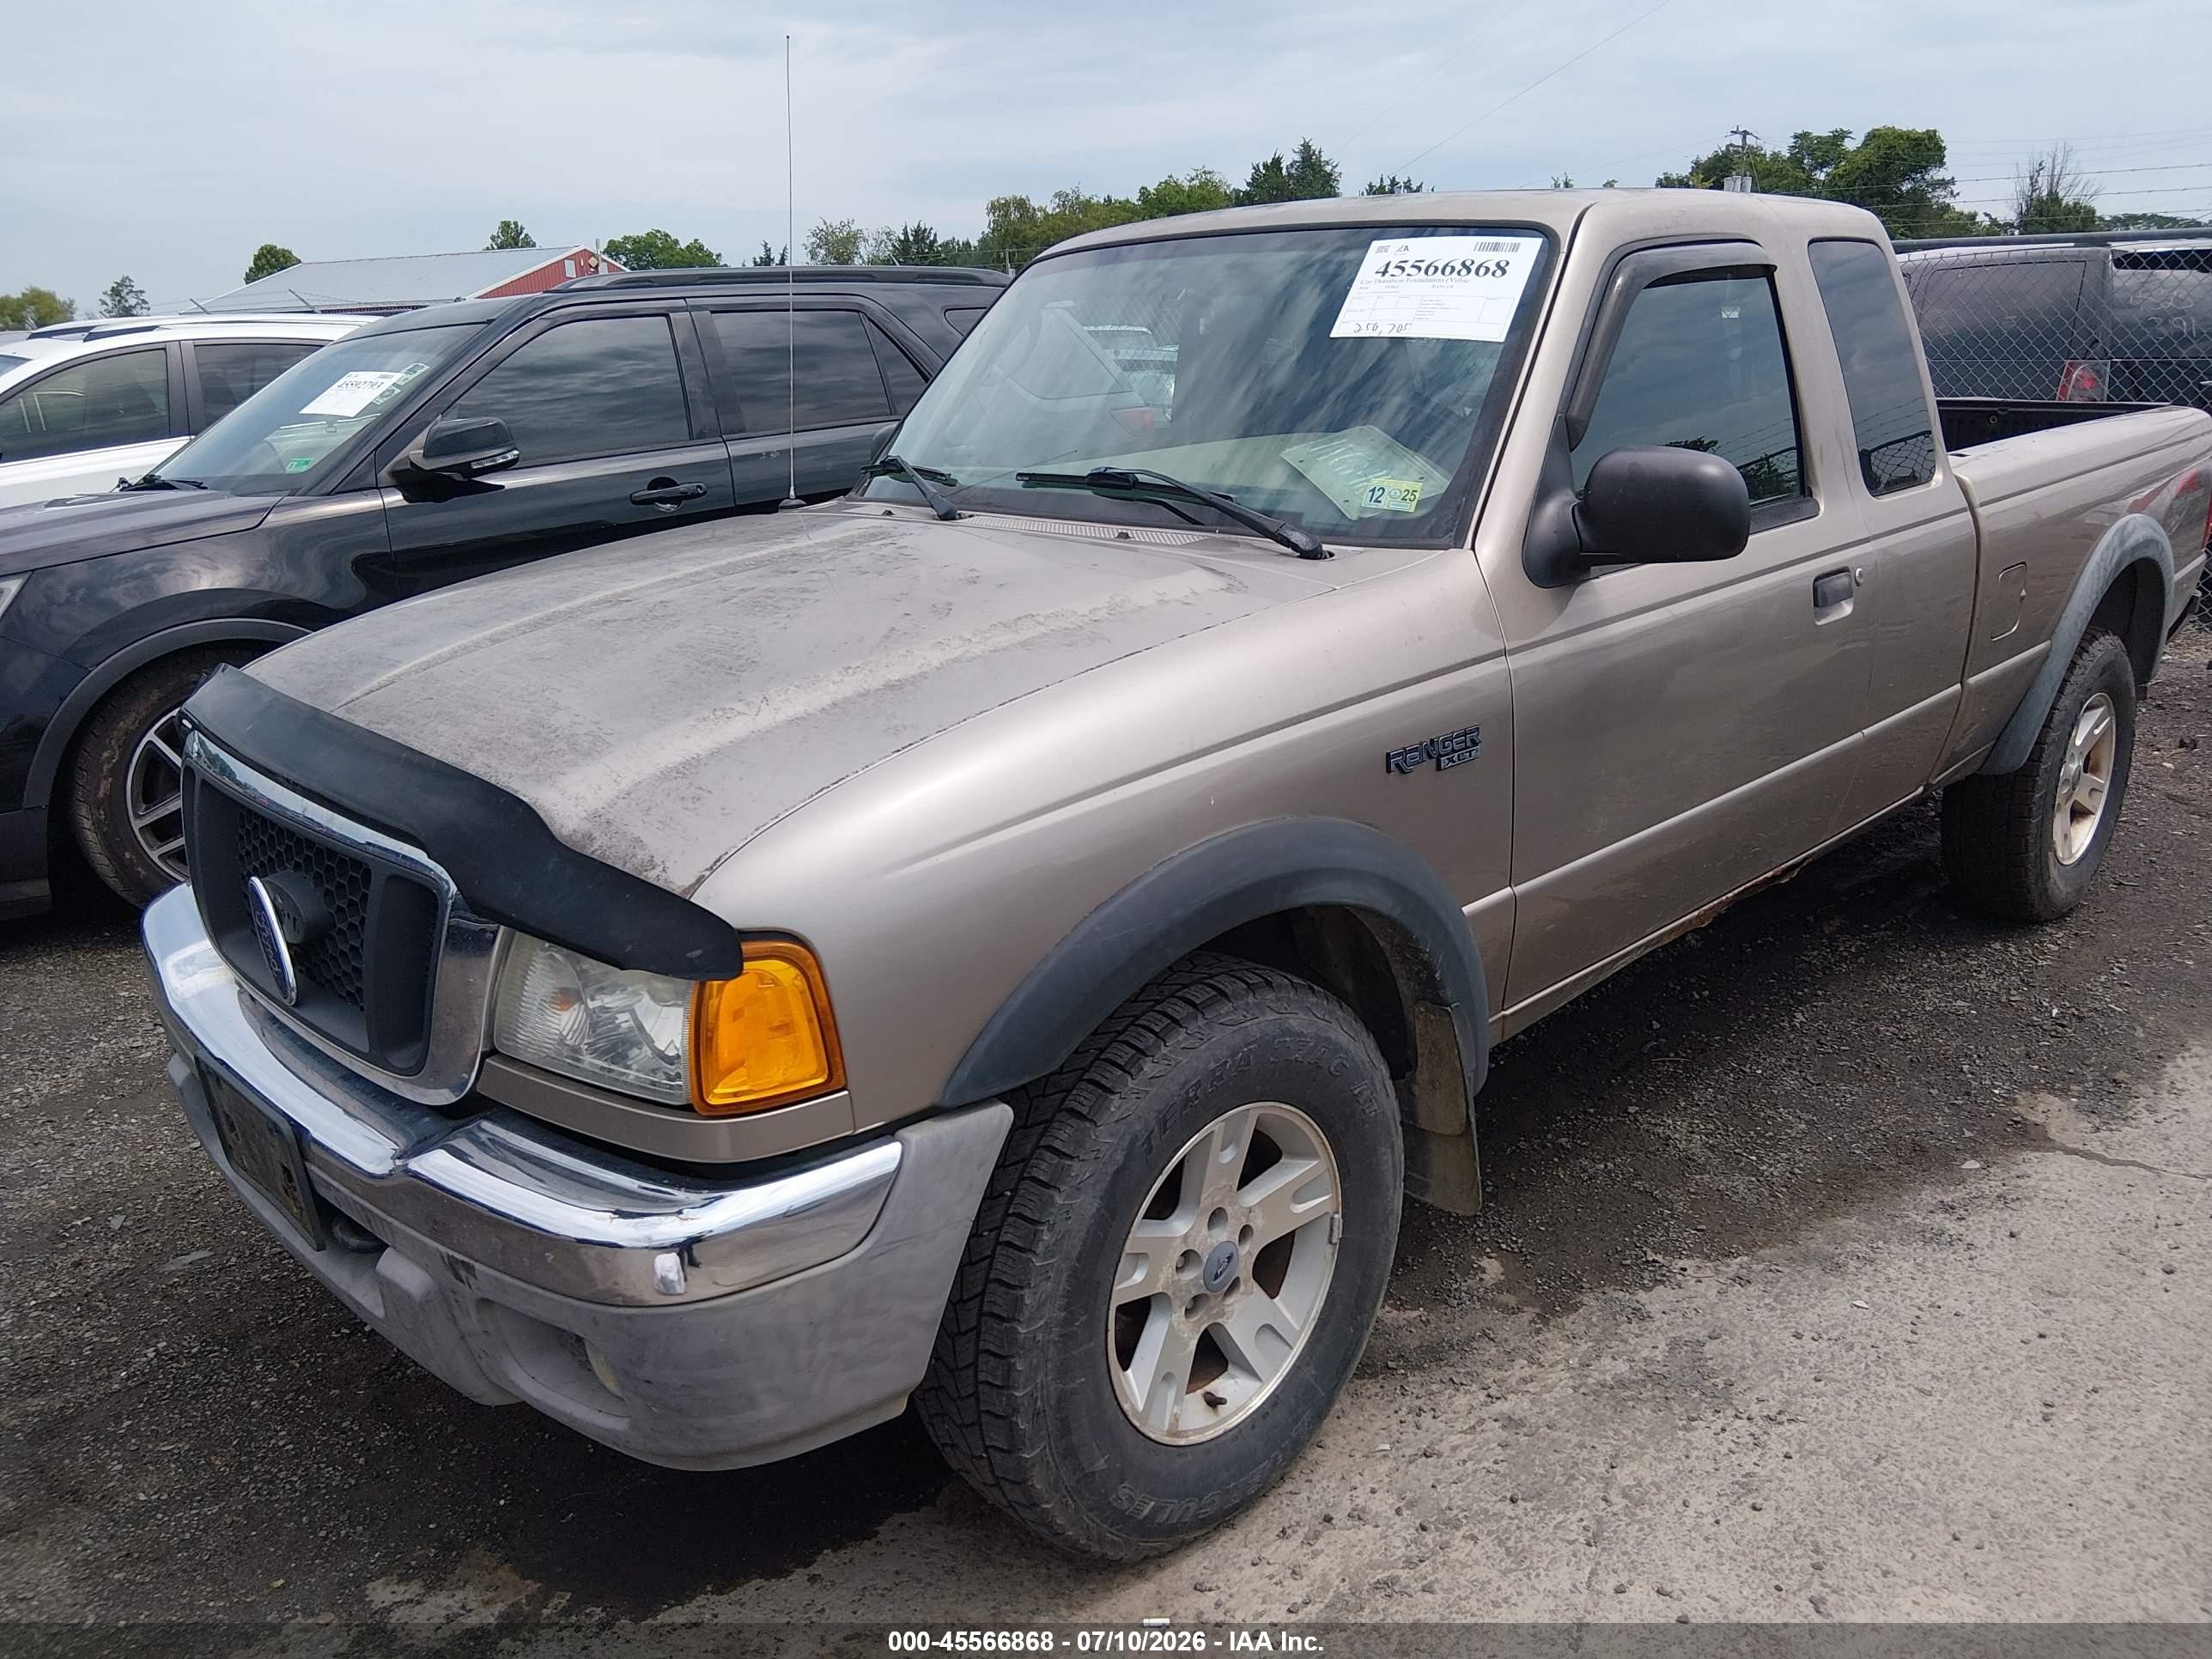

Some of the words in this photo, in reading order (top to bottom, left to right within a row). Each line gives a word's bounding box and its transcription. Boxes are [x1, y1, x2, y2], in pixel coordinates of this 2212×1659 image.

[1375, 258, 1510, 278] 45566868
[1368, 486, 1385, 503] 12
[1401, 489, 1418, 502] 25
[1387, 725, 1482, 773] RANGER
[1443, 748, 1478, 769] XLT
[255, 910, 282, 978] Ford
